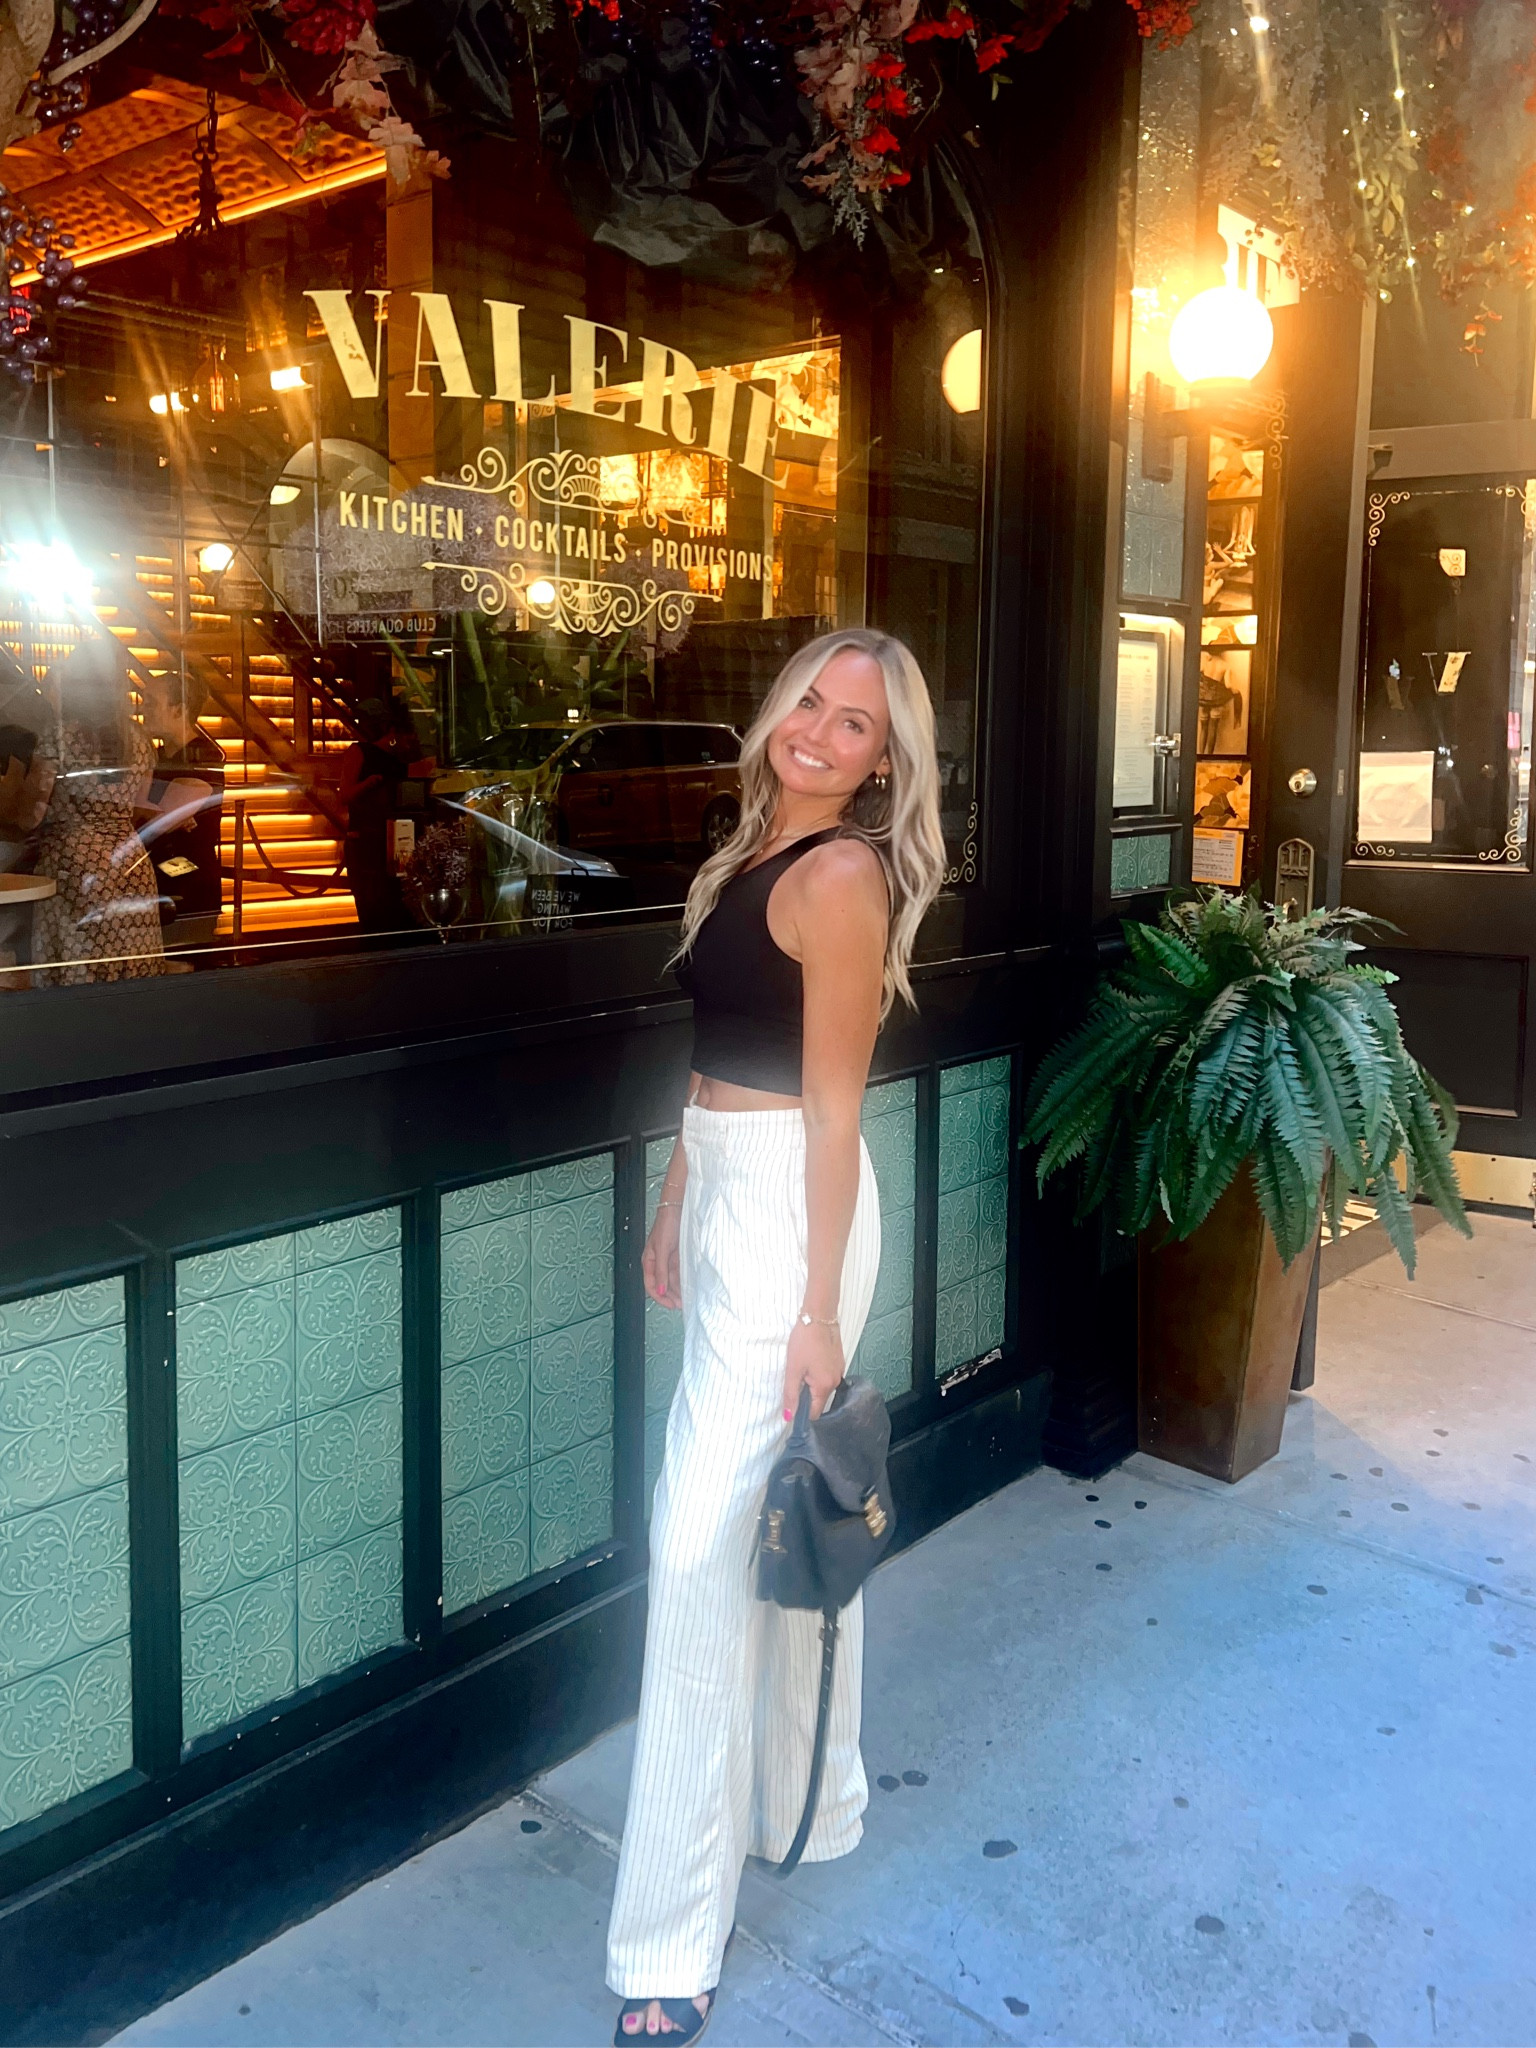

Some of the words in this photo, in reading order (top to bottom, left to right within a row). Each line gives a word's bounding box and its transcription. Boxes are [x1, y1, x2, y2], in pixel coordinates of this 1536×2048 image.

[302, 288, 797, 490] VALERIE
[339, 490, 465, 542] KITCHEN
[494, 513, 627, 564] COCKTAILS
[652, 537, 774, 582] PROVISIONS
